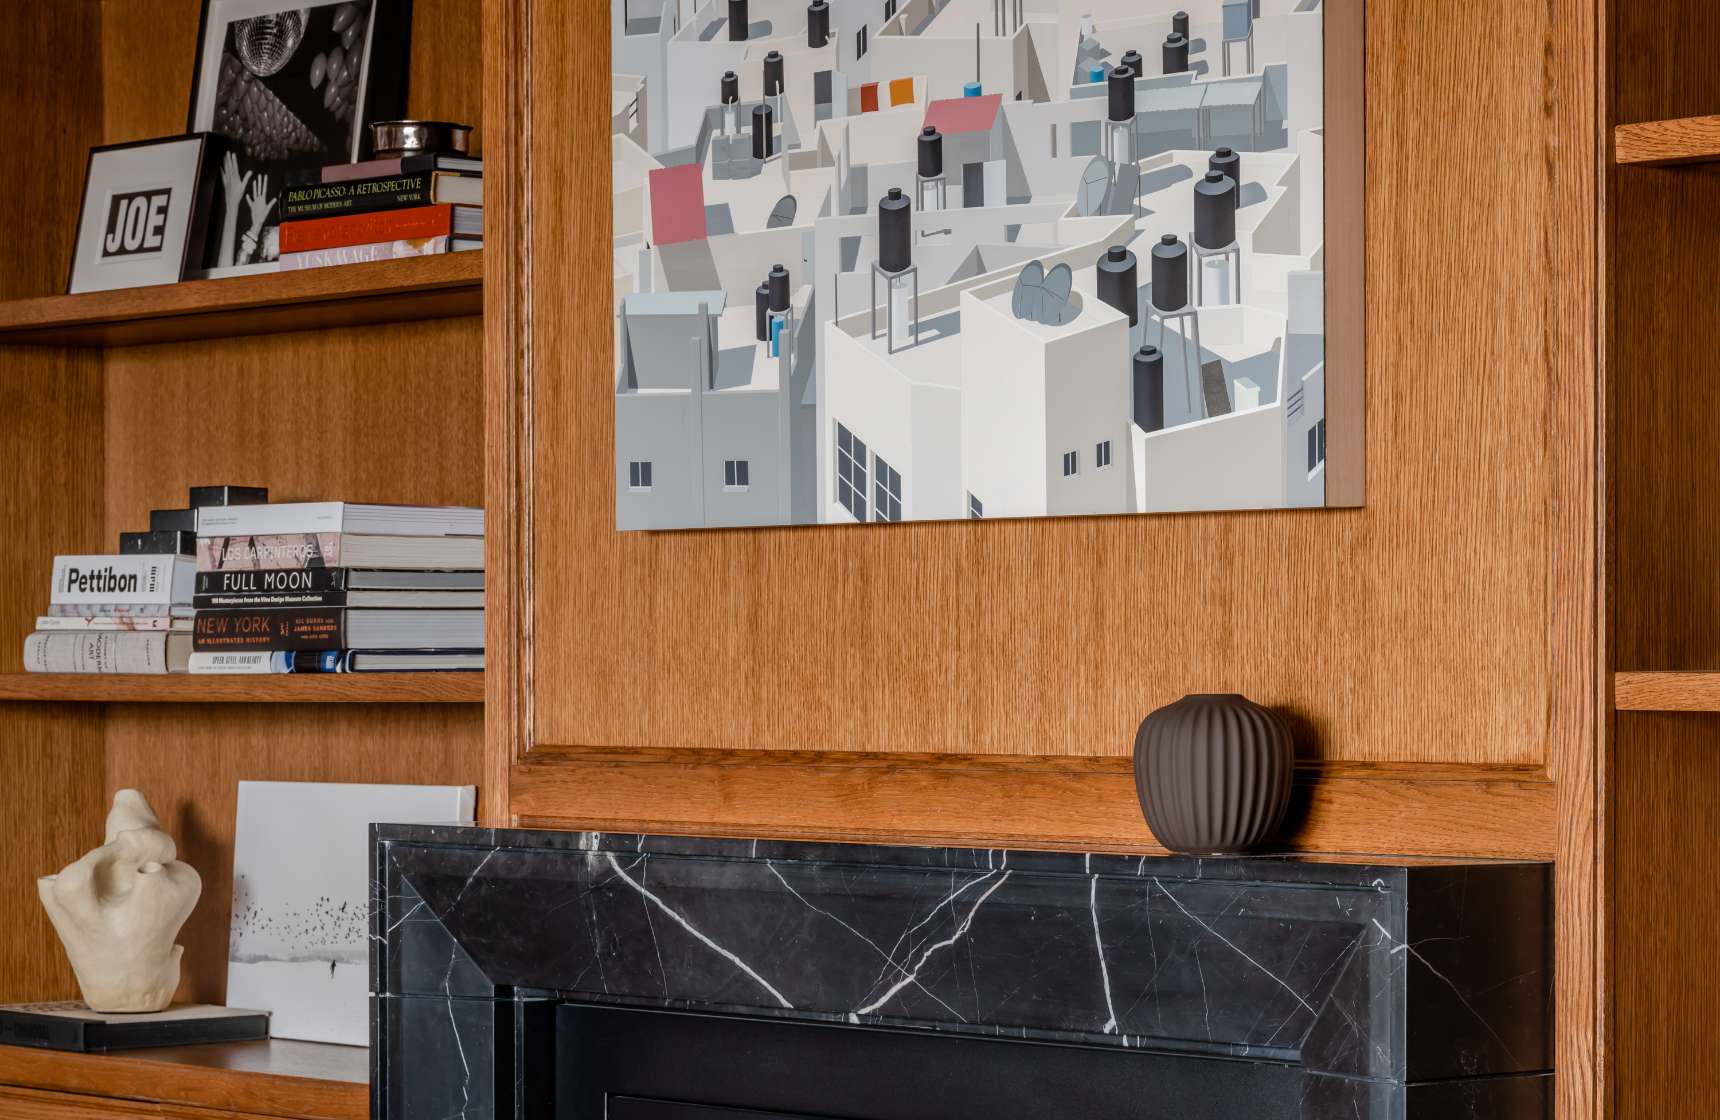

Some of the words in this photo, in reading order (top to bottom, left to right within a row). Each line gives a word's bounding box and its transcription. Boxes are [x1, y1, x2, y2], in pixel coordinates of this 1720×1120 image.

[288, 189, 312, 202] PABLO
[348, 186, 355, 196] A
[356, 177, 422, 195] RETROSPECTIVE
[106, 194, 168, 253] JOE
[222, 547, 241, 561] LOS
[244, 544, 314, 560] CARPINTEROS
[67, 566, 138, 593] Pettibon
[223, 573, 257, 591] FULL
[264, 571, 312, 589] MOON
[197, 618, 229, 634] NEW
[234, 616, 271, 633] YORK
